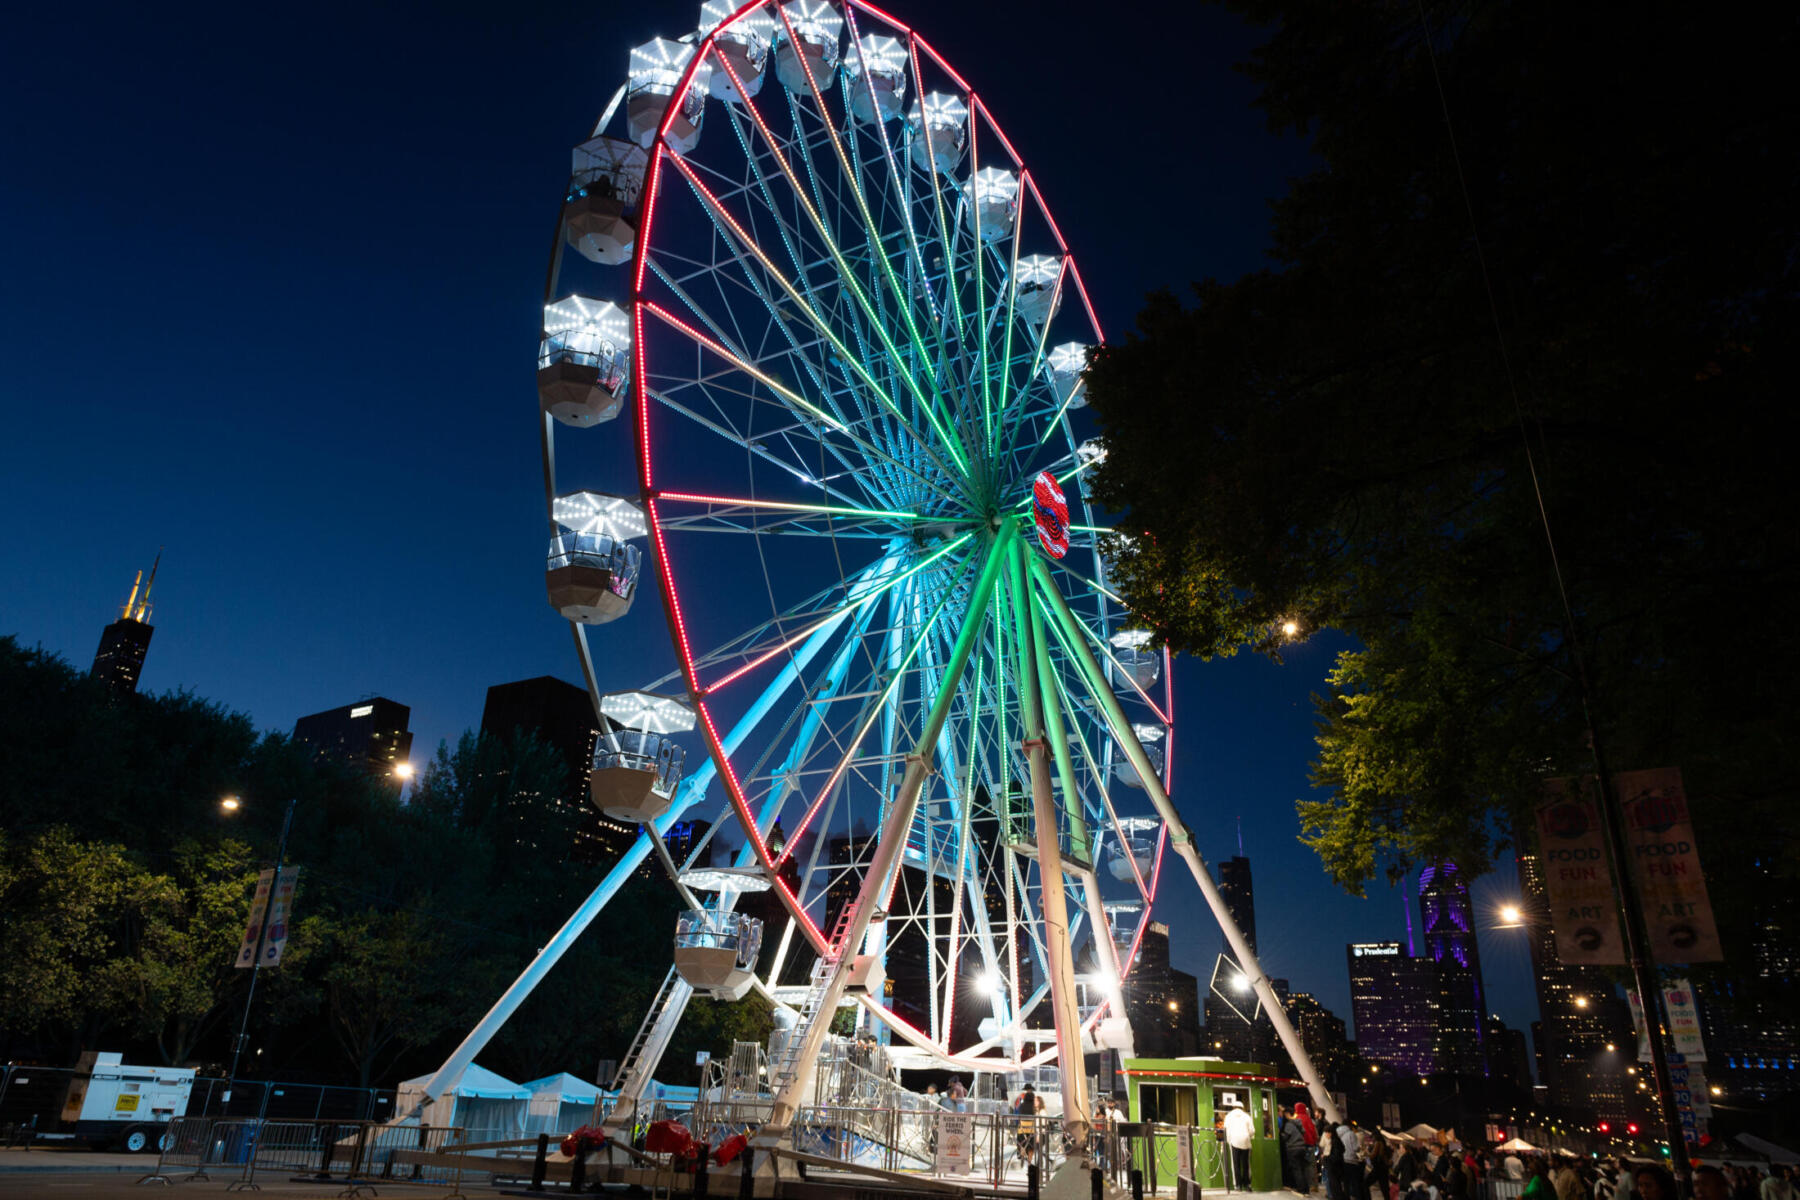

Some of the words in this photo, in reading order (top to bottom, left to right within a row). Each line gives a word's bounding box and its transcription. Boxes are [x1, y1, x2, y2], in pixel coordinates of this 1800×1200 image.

[1548, 848, 1600, 862] FOOD
[1636, 841, 1690, 857] FOOD
[1559, 867, 1597, 881] FUN
[1648, 862, 1687, 877] FUN
[1568, 906, 1604, 920] ART
[1658, 902, 1697, 918] ART
[1363, 947, 1399, 956] Prudential
